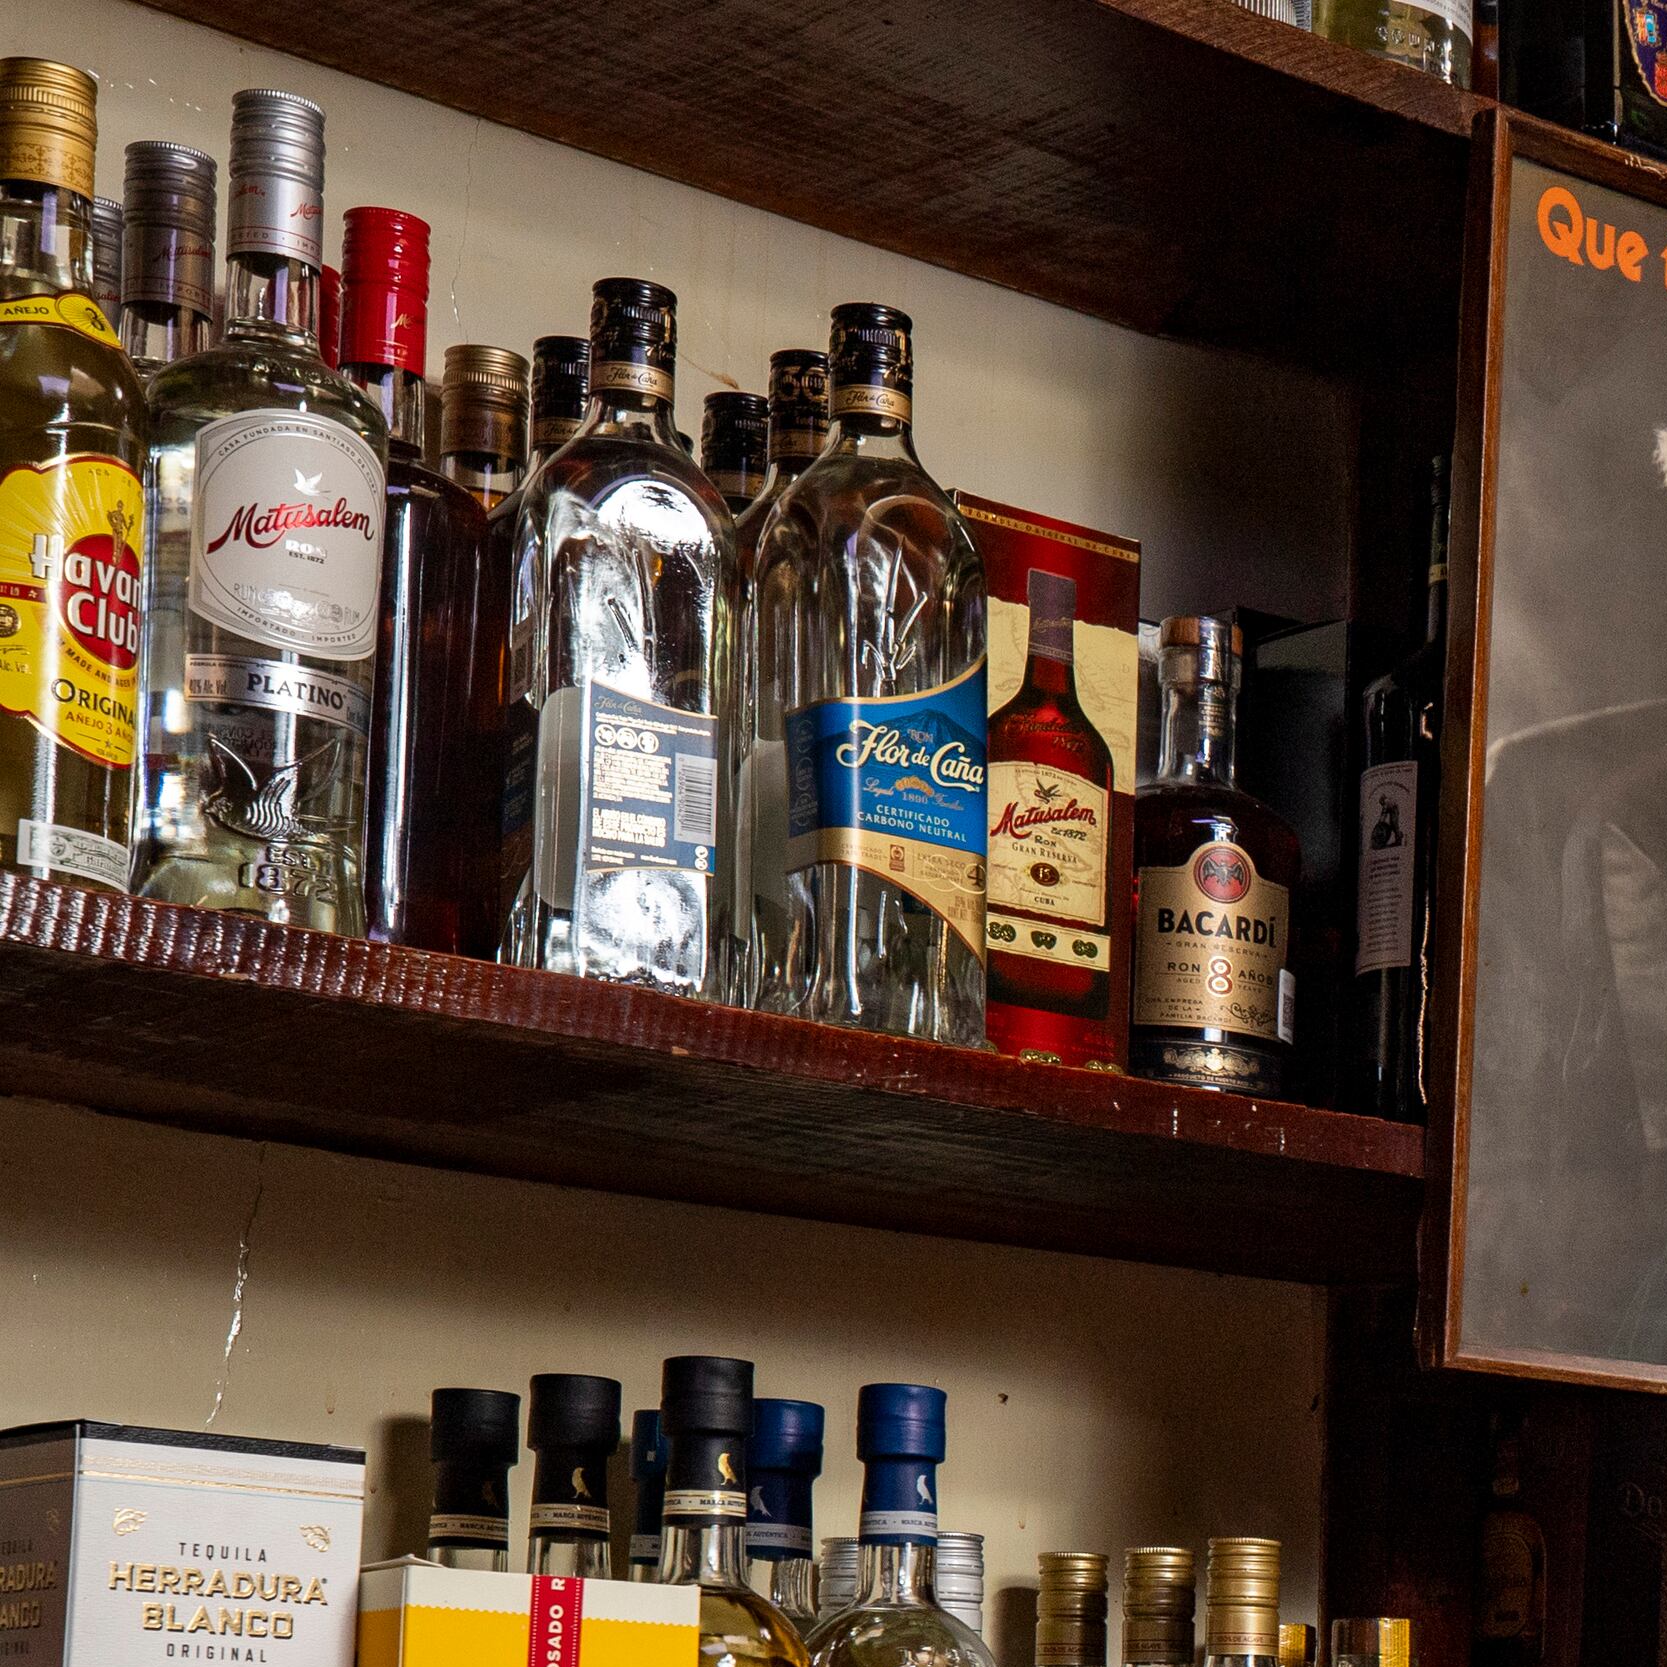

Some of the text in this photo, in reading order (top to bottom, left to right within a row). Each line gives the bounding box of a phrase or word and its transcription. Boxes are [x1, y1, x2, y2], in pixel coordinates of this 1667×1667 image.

[1537, 186, 1649, 282] Que
[4, 306, 49, 315] AÑEJO
[219, 439, 240, 457] CASA
[244, 426, 290, 440] FUNDADA
[207, 497, 374, 554] Matusalem
[30, 532, 142, 603] Havan
[67, 592, 138, 654] Club
[236, 606, 357, 643] IMPORTADO IMPORTED
[67, 648, 92, 672] MADE
[51, 678, 135, 730] ORIGINA
[246, 672, 344, 710] PLATINO
[65, 711, 113, 735] AÑEJO 3
[835, 720, 984, 793] Flor de Caña
[856, 811, 967, 842] CARBONO NEUTRAL
[876, 804, 950, 827] CERTIFICADO
[989, 798, 1097, 839] Matusalem
[1012, 841, 1037, 856] GRAN
[967, 862, 984, 886] 4
[1034, 895, 1056, 907] CUBA
[1157, 908, 1277, 949] BACARDÍ
[1176, 941, 1206, 949] GRAN
[1167, 961, 1200, 973] RON
[1206, 956, 1233, 998] 8
[179, 1542, 267, 1563] TEQUILA
[108, 1560, 328, 1606] HERRADURA
[141, 1601, 294, 1640] BLANCO
[166, 1643, 267, 1663] ORIGINAL
